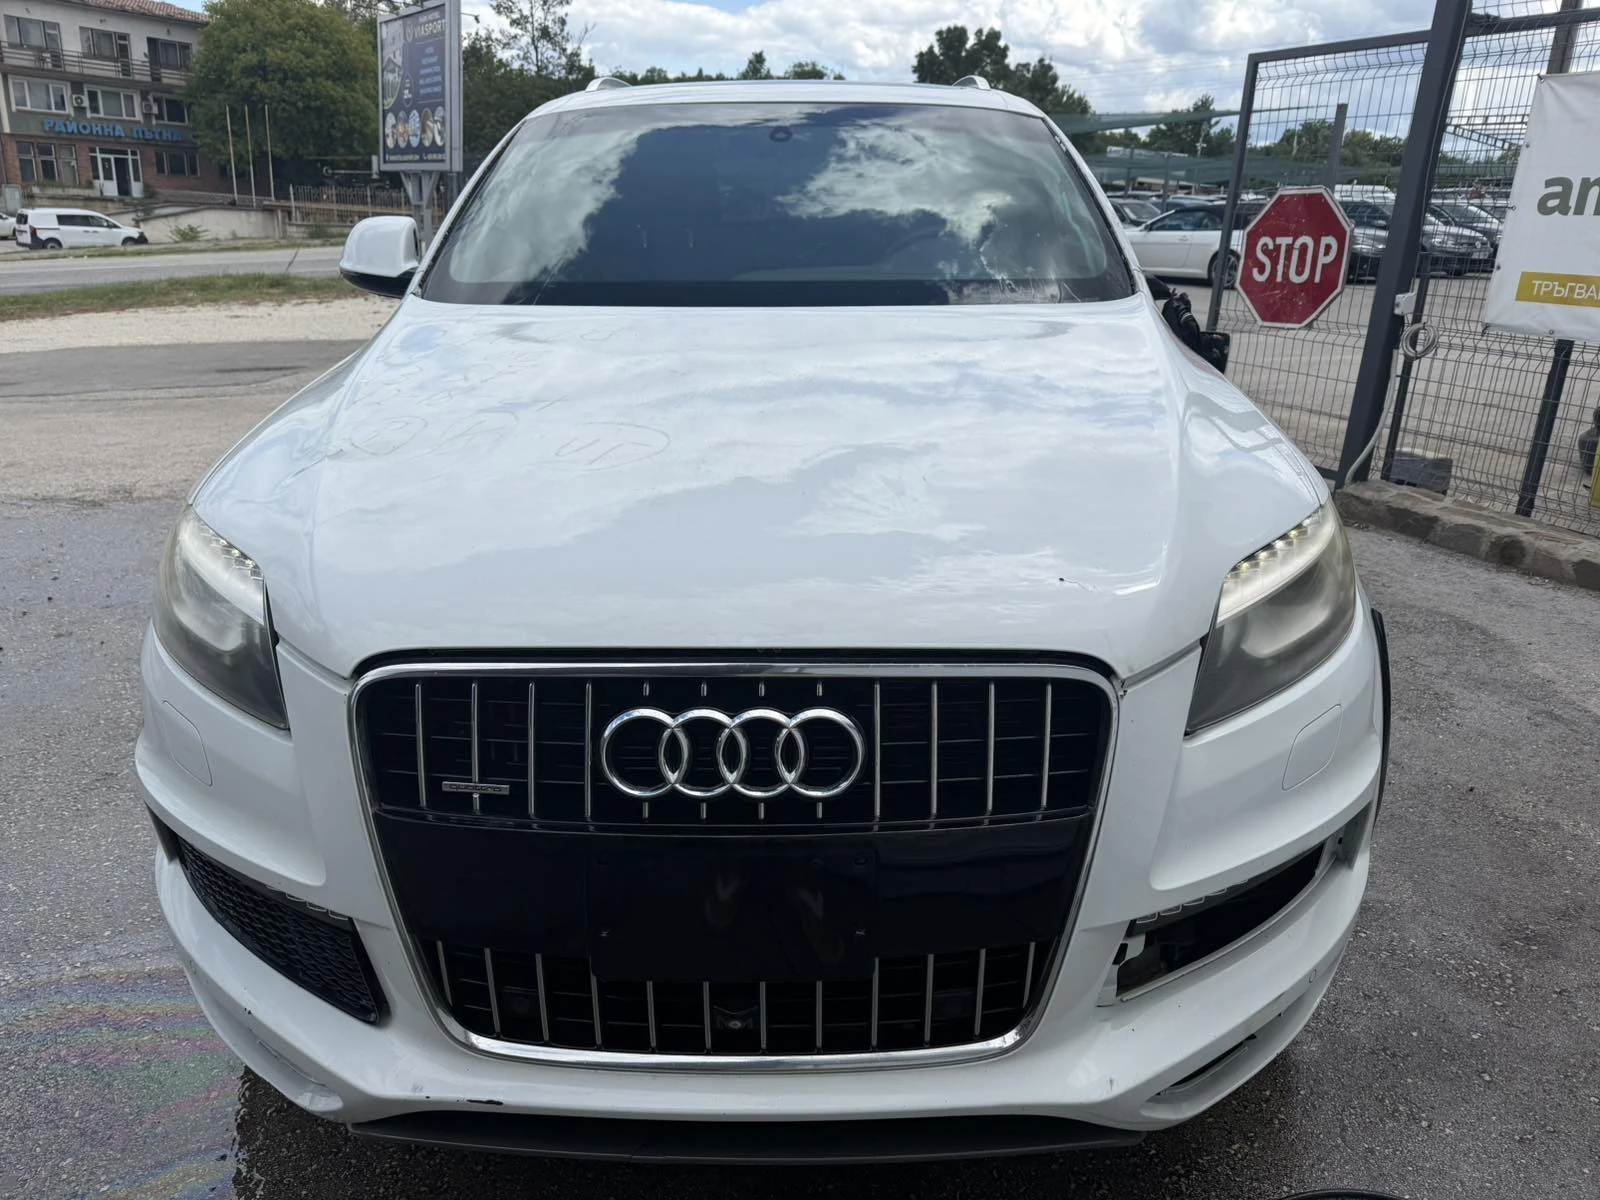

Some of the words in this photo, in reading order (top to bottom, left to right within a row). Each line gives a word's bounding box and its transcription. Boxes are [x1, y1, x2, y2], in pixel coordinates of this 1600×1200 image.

[44, 118, 125, 137] РАЙОННА
[1252, 235, 1338, 284] STOP
[1532, 280, 1600, 301] ТРЪГВА
